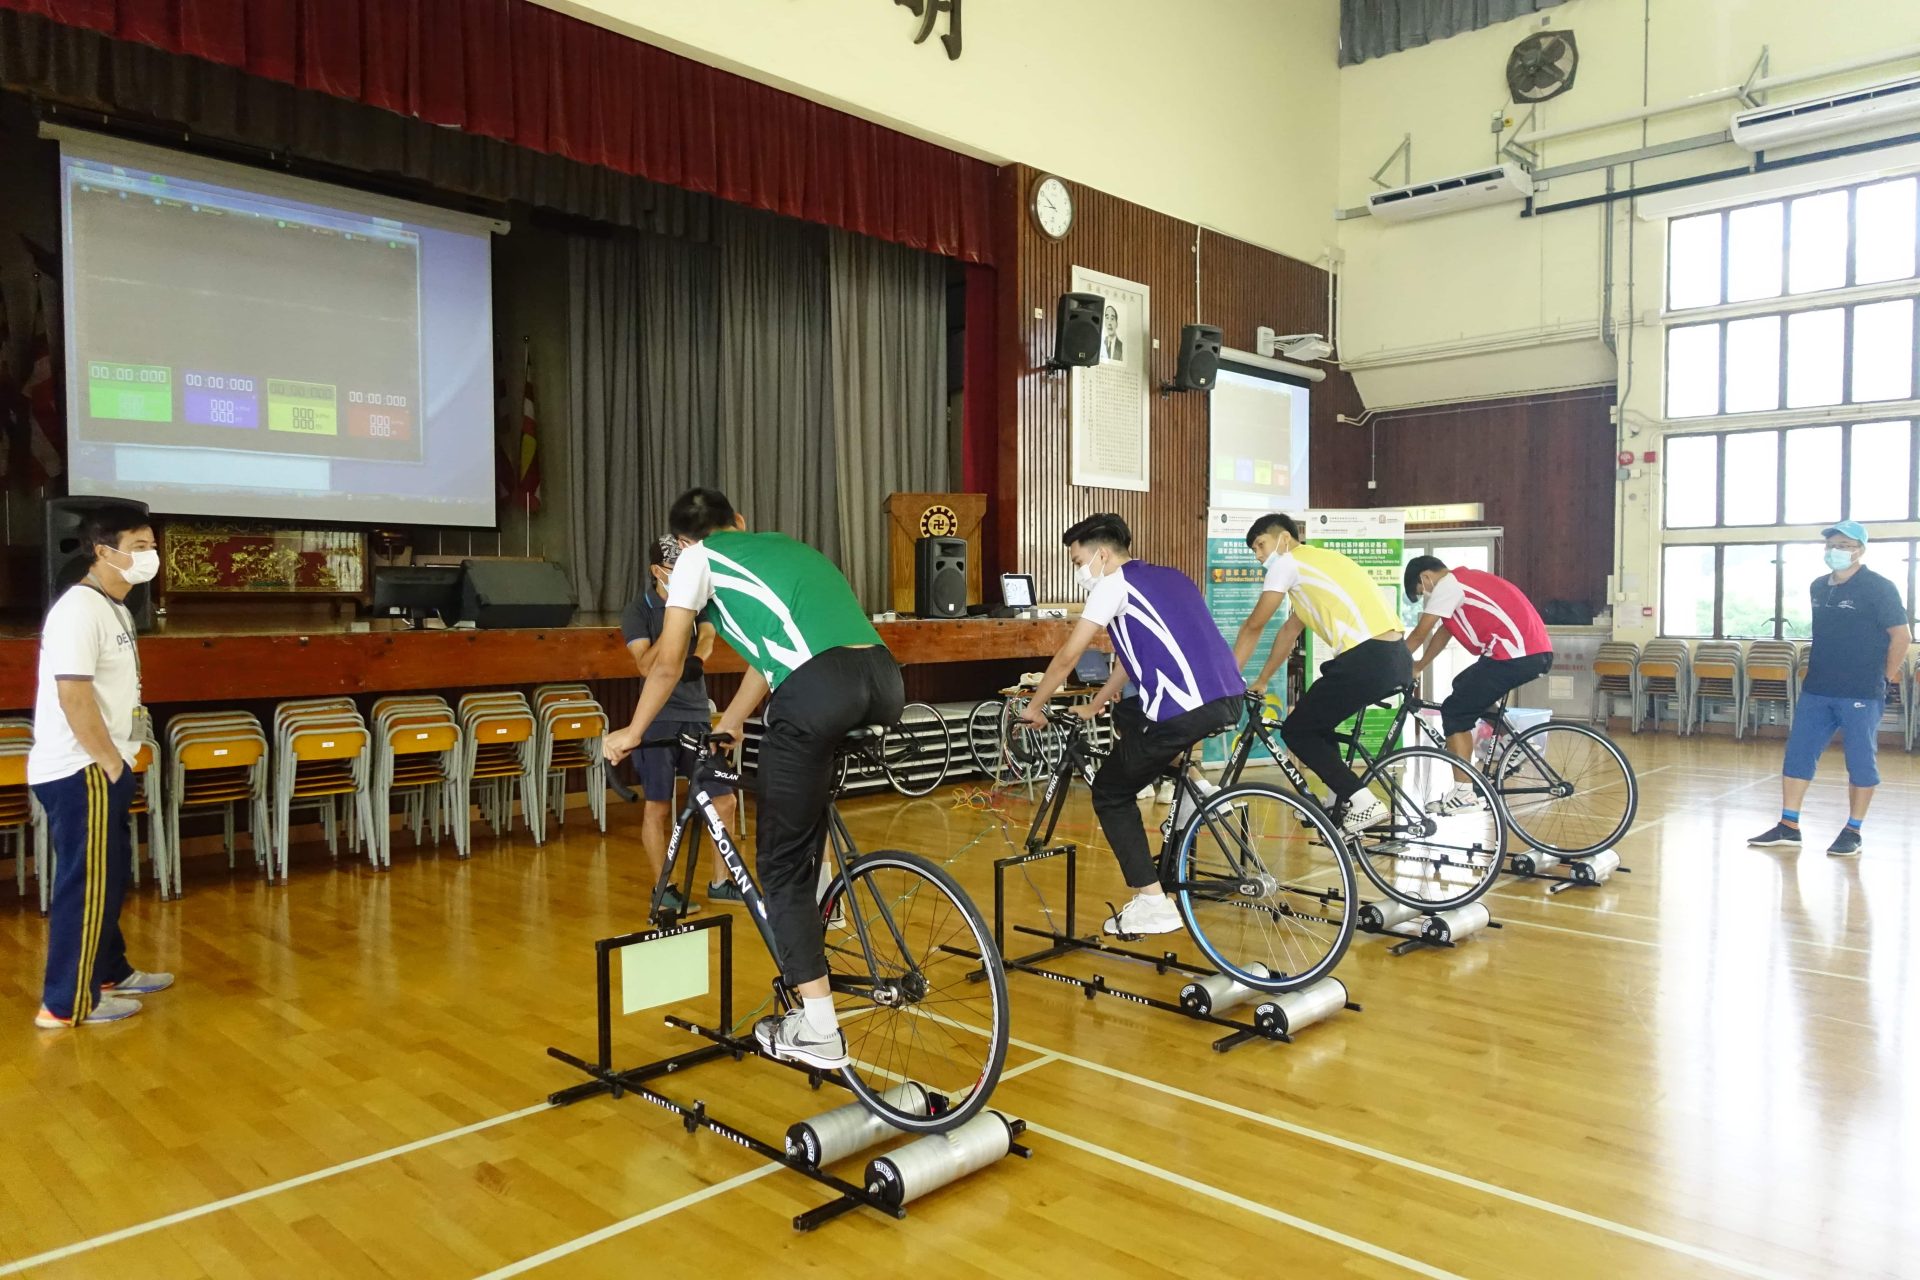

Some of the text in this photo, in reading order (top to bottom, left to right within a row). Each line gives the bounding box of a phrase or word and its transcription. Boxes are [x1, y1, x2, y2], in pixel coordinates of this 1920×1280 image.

[1408, 509, 1426, 520] XIT
[644, 926, 695, 940] KREITLER
[1043, 972, 1149, 1005] KREITLER ROLLERS
[643, 1092, 749, 1148] KREITLER ROLLERS
